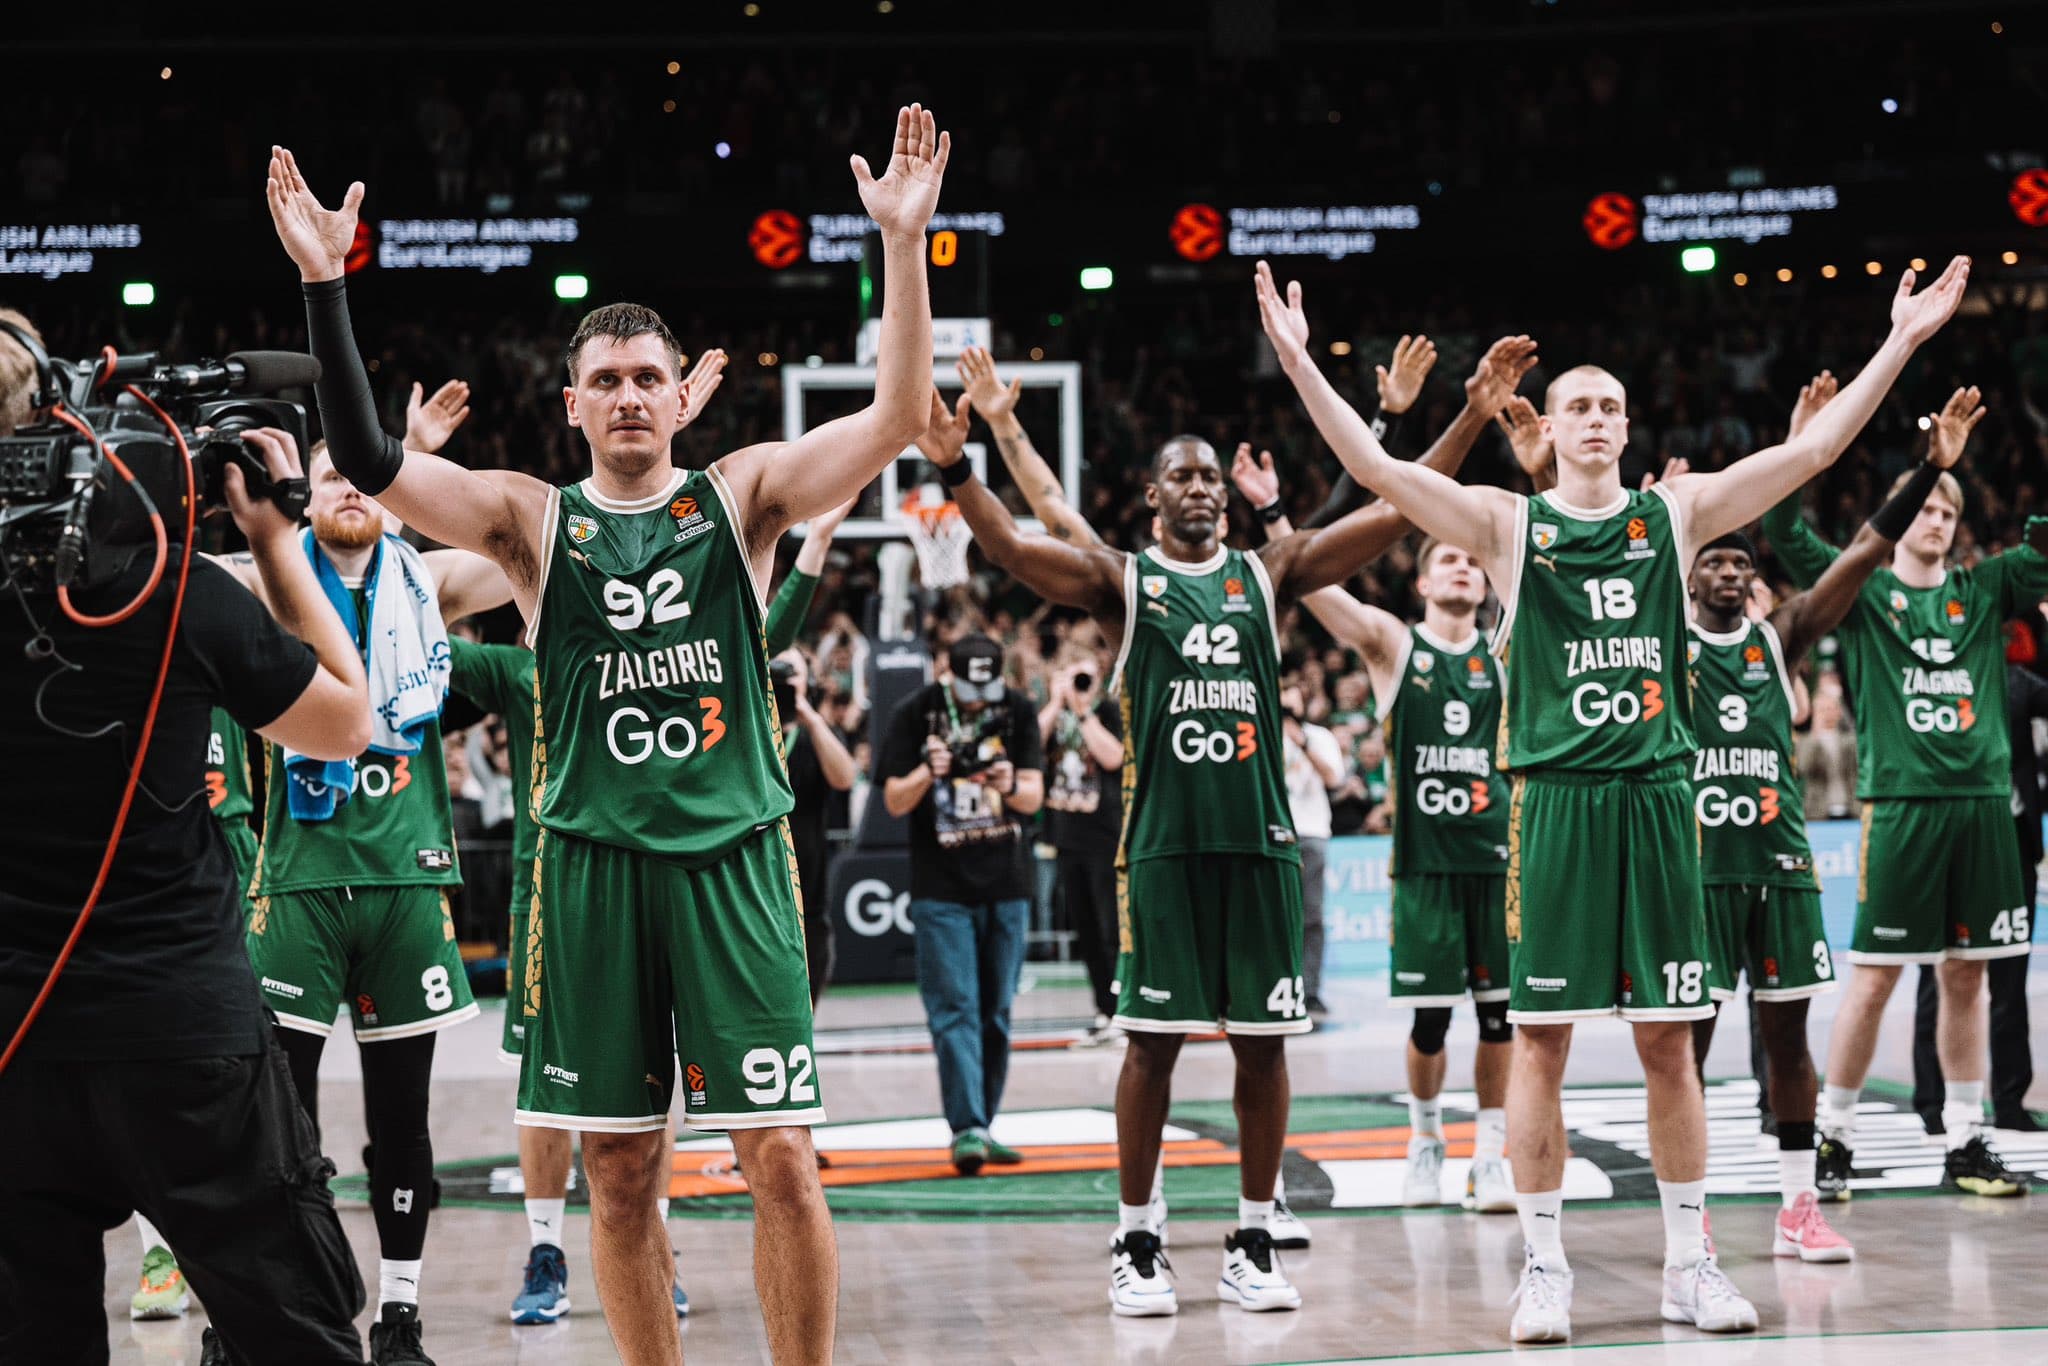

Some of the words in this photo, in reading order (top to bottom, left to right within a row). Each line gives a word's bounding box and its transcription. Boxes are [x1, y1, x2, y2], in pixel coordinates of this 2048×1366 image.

[41, 224, 141, 248] AIRLINES
[931, 231, 957, 266] 0
[0, 249, 93, 281] League
[603, 568, 691, 631] 92
[1583, 578, 1637, 620] 18
[1182, 623, 1241, 664] 42
[1443, 700, 1471, 736] 9
[1572, 679, 1664, 727] Go3
[1718, 694, 1748, 732] 3
[1906, 698, 1976, 733] Go3
[606, 696, 727, 765] Go3
[1172, 720, 1258, 763] Go3
[350, 756, 412, 797] o3
[1416, 778, 1490, 815] Go3
[1695, 786, 1780, 827] Go3
[845, 879, 916, 937] Go
[1990, 906, 2029, 944] 45
[1812, 940, 1831, 979] 3
[421, 965, 453, 1011] 8
[1662, 961, 1703, 1004] 18
[742, 1044, 815, 1105] 92
